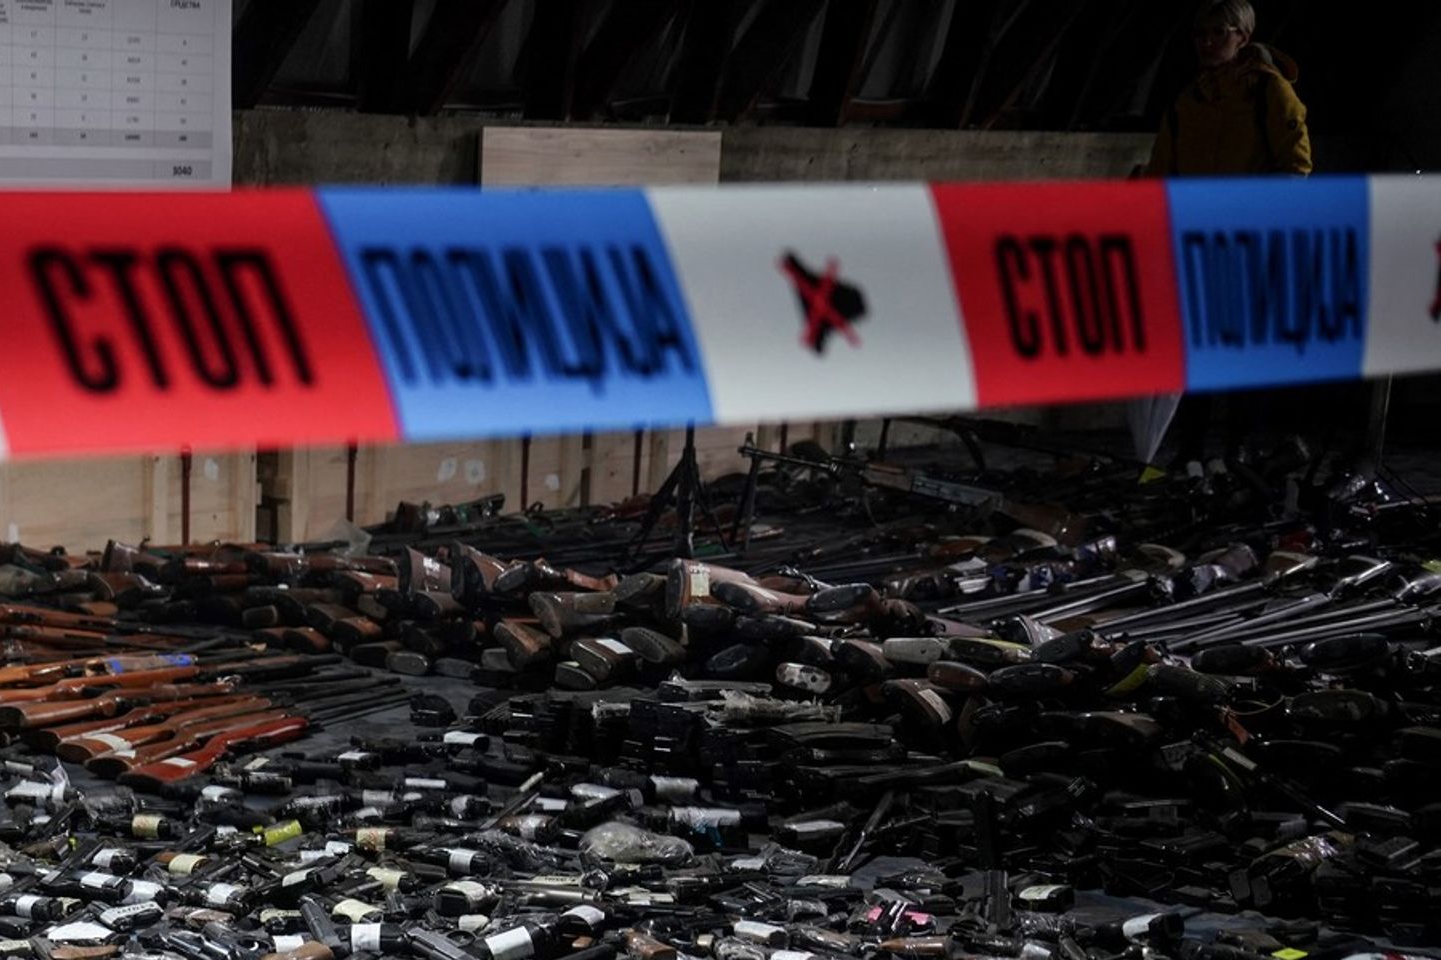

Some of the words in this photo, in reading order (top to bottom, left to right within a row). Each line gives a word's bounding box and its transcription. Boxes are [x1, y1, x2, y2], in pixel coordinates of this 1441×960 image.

[25, 243, 316, 396] СТОП
[360, 243, 697, 396] ПОЛИЦИЈА
[992, 231, 1148, 360] СТОП
[1182, 225, 1362, 356] ПОЛИЦИЈА
